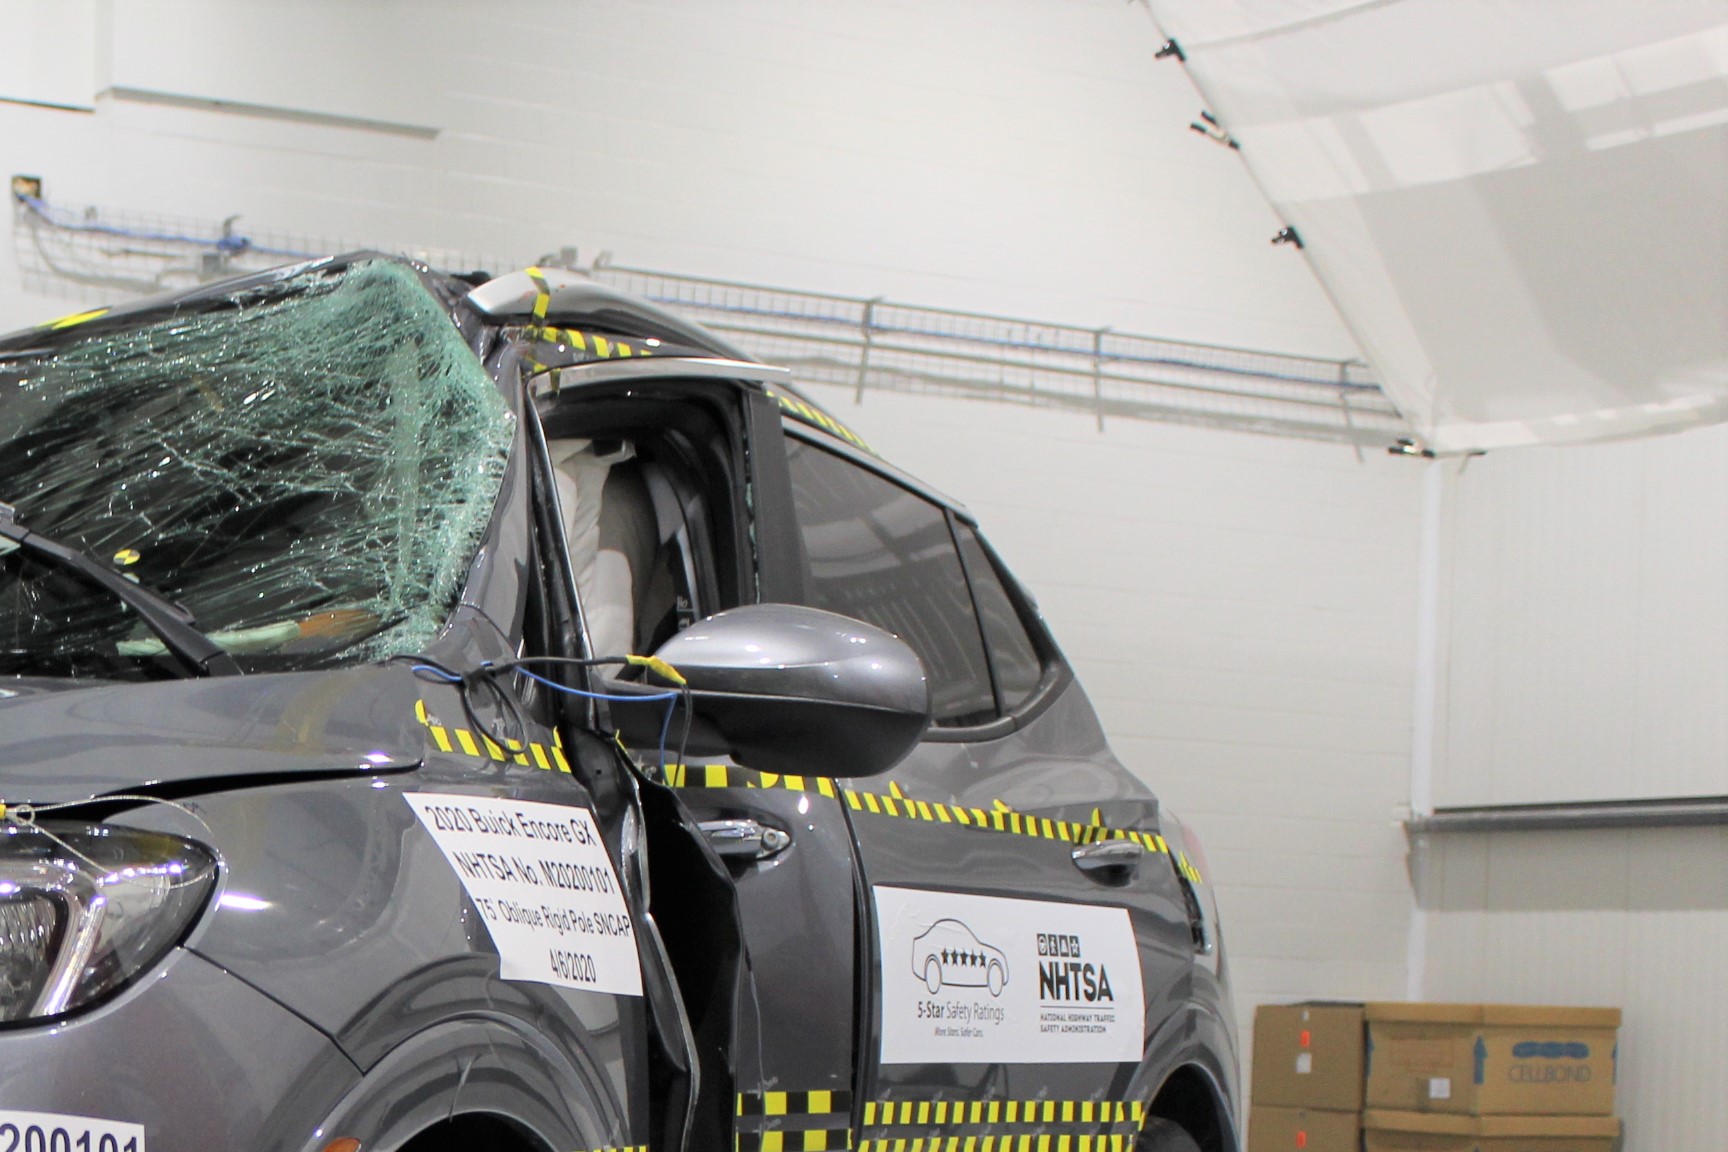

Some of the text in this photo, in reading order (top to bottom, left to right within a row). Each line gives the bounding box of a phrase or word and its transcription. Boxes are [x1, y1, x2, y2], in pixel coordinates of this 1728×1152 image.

[425, 805, 598, 847] 2020 Buick Encore GX
[452, 851, 616, 895] NHTSA No. M20200101
[498, 899, 543, 933] Oblique
[541, 905, 570, 937] Rigid
[569, 910, 596, 935] Pole
[593, 912, 632, 938] SNCAP
[549, 948, 598, 984] 4/6/2020
[1038, 960, 1115, 1002] NHTSA
[917, 1001, 1006, 1026] 5-Star Safety Ratings
[1508, 1064, 1592, 1084] CELLBOND
